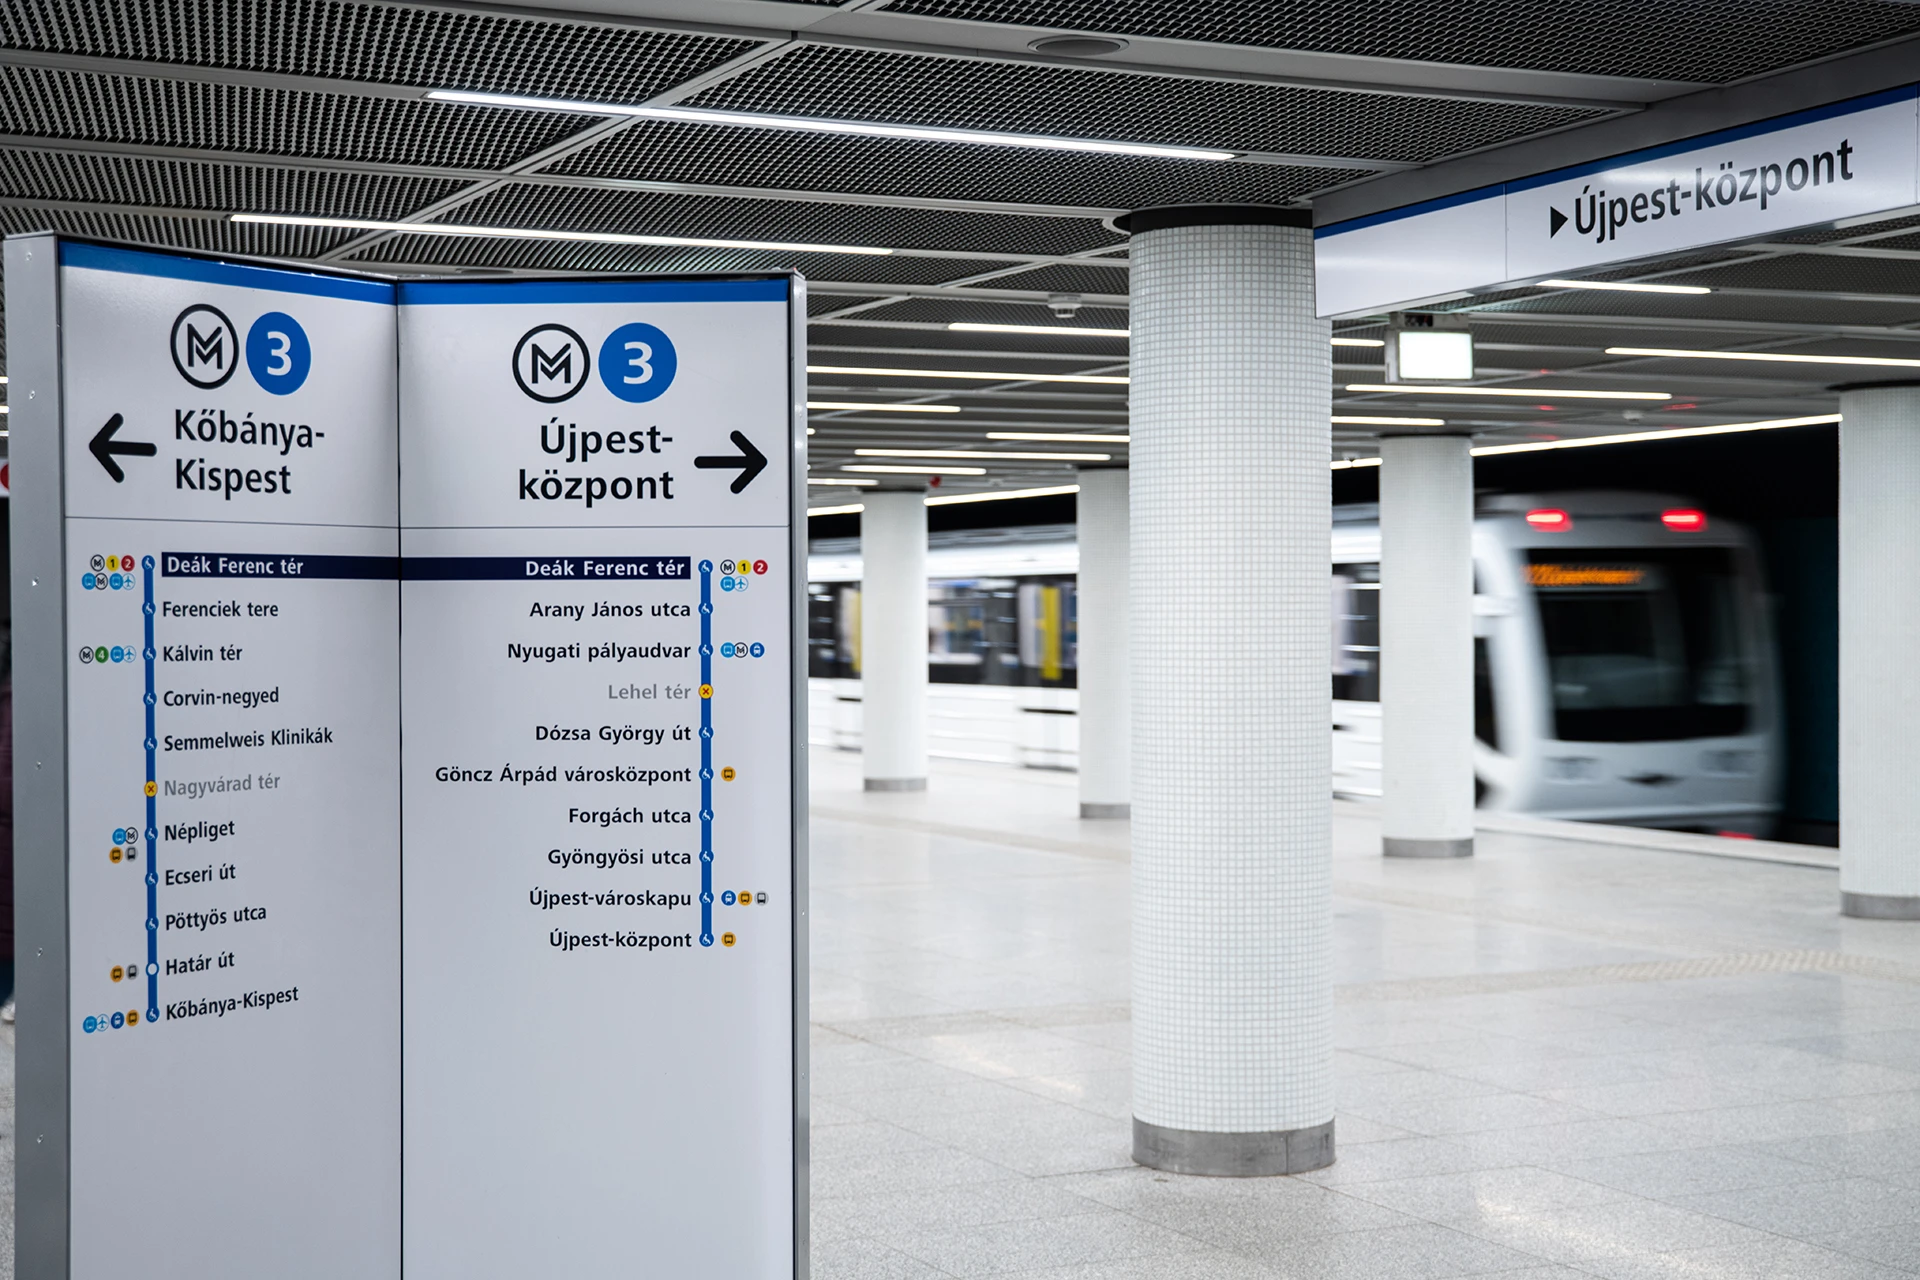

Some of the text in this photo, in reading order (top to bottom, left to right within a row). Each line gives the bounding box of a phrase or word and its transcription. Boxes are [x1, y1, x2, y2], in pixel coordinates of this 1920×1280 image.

[1573, 137, 1855, 244] Újpest-központ
[267, 331, 292, 376] 3
[623, 341, 653, 385] 3
[175, 408, 325, 456] Kőbánya-
[540, 416, 673, 463] Újpest-
[175, 457, 292, 501] Kispest
[519, 468, 674, 509] központ
[167, 555, 305, 579] Deák Ferenc tér
[526, 559, 685, 576] Deák Ferenc tér
[162, 599, 279, 618] Ferenciek tere
[529, 600, 691, 620] Arany János utca
[163, 643, 243, 663] Kálvin tér
[507, 641, 692, 661] Nyugati pályaudvar
[163, 686, 279, 709] Corvin-negyed
[608, 683, 692, 700] Lehel tér
[163, 726, 334, 752] Semmelweis Klinikák
[535, 724, 692, 746] Dózsa György út
[164, 772, 281, 800] Nagyvárad tér
[435, 762, 692, 787] Göncz Árpád városközpont
[569, 806, 691, 828] Forgách utca
[164, 820, 236, 845] Népliget
[547, 848, 691, 869] Gyöngyösi utca
[165, 862, 237, 887] Ecseri út
[529, 887, 691, 911] Újpest-városkapu
[165, 906, 267, 932] Pöttyös utca
[549, 929, 692, 952] Újpest-központ
[165, 950, 235, 976] Határ út
[166, 986, 299, 1021] Kőbánya-Kispest
